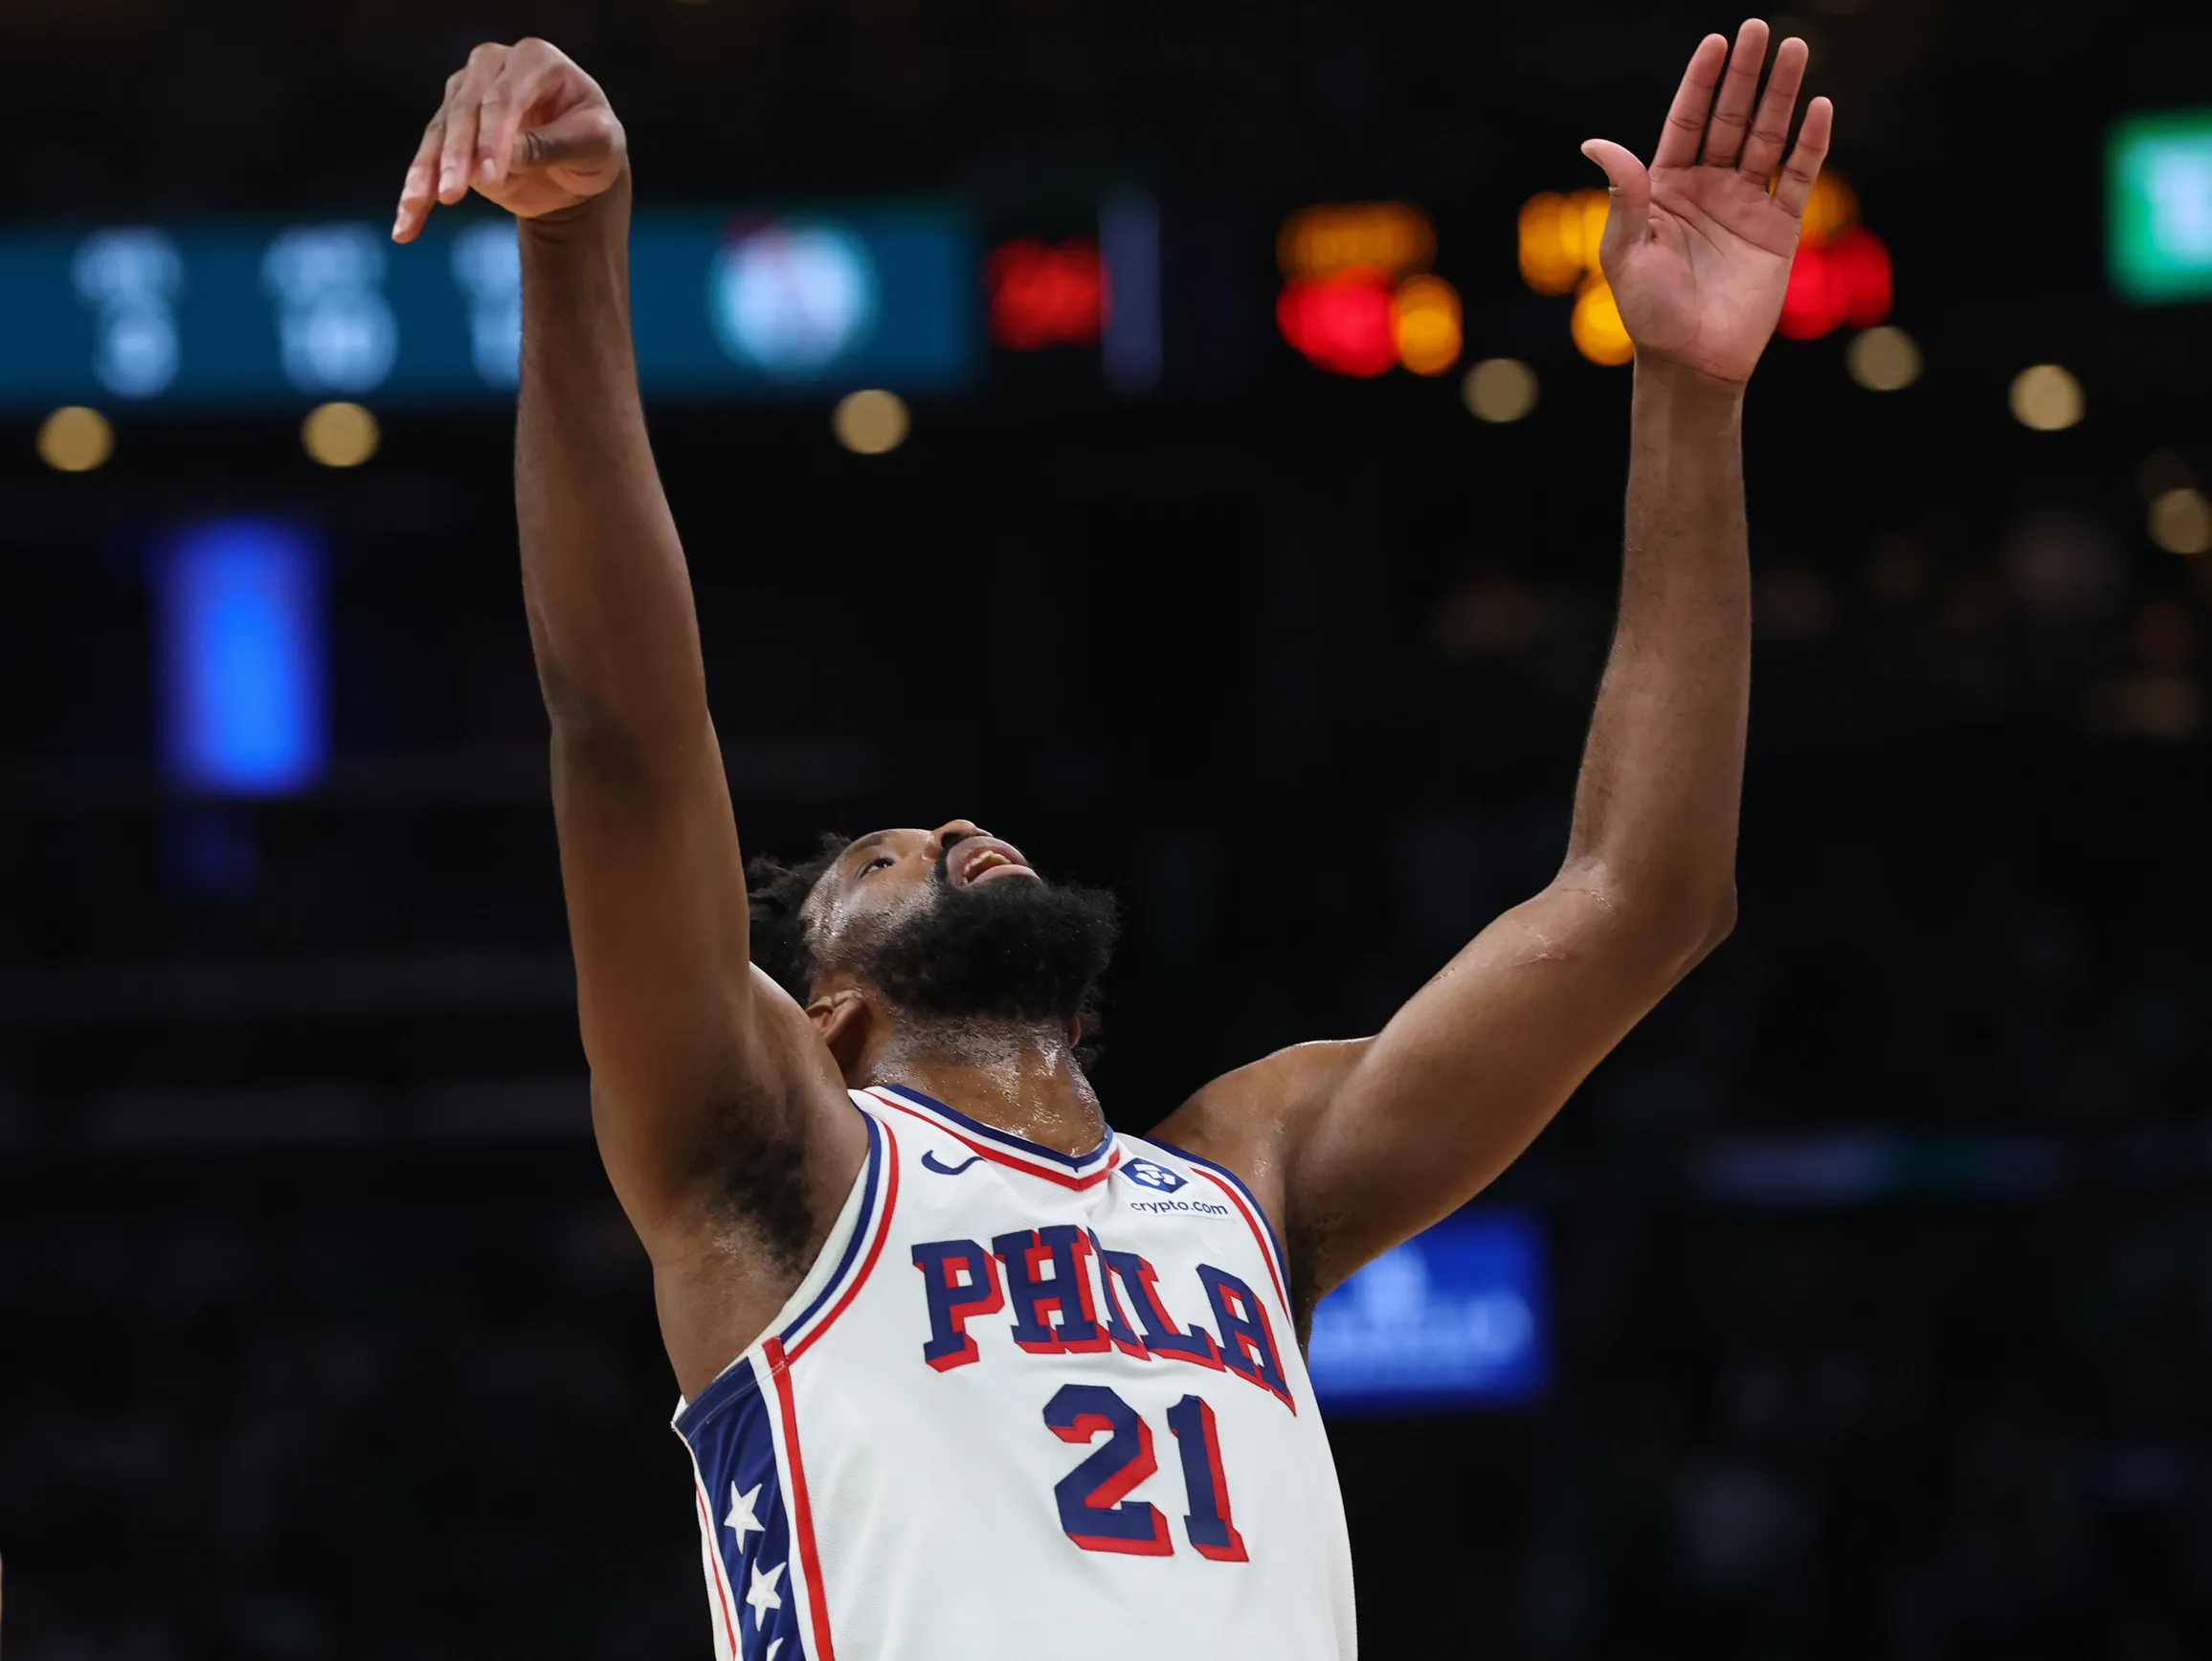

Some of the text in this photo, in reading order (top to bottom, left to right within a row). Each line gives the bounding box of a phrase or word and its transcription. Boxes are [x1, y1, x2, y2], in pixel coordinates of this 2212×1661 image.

[1129, 1200, 1229, 1215] crypto.com
[911, 1224, 1297, 1417] PHILA
[1042, 1384, 1249, 1562] 21
